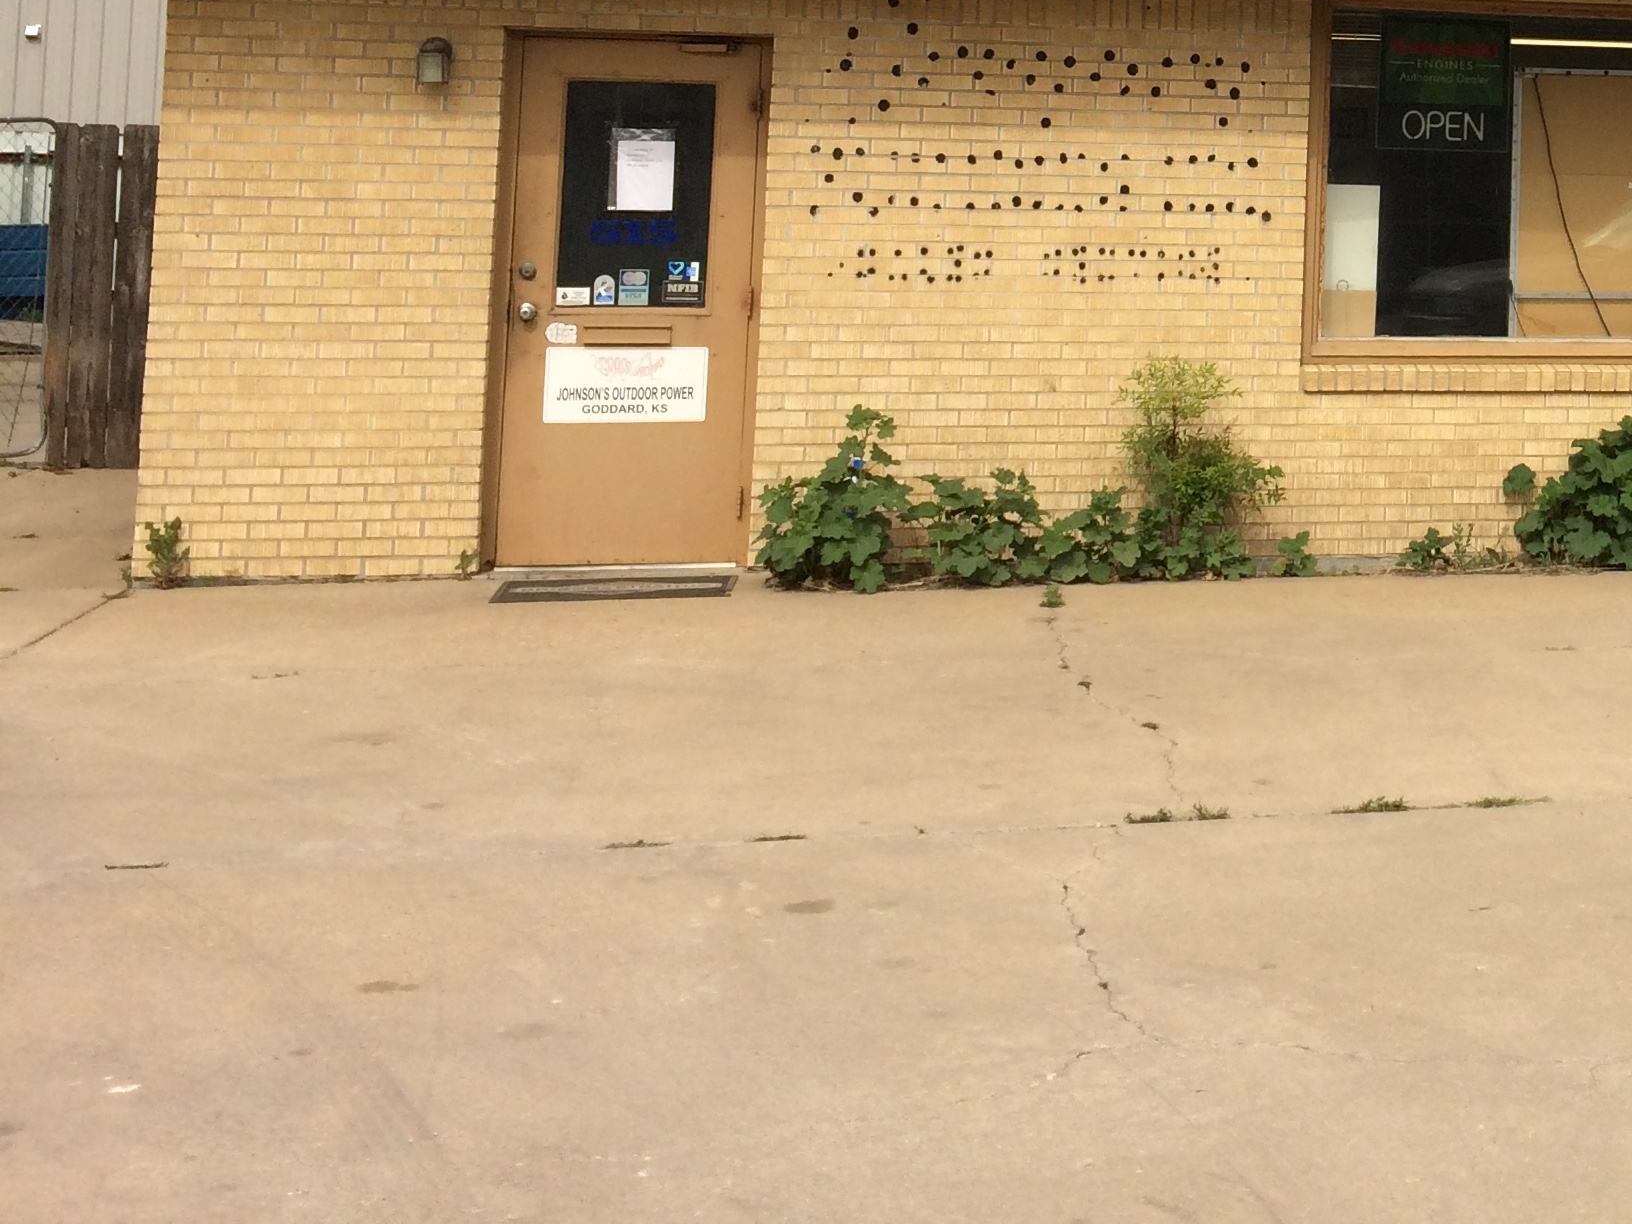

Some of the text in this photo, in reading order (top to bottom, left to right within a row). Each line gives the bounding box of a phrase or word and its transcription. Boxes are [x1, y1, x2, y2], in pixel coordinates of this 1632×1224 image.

[1416, 59, 1474, 71] ENGINES
[1400, 72, 1490, 85] Authorized Dealer
[1402, 110, 1485, 142] OPEN
[589, 219, 679, 246] 515
[666, 283, 699, 293] NFIB
[556, 386, 694, 401] JOHNSON'S OUTDOOR POWER
[581, 403, 668, 415] GODDARD, KS
